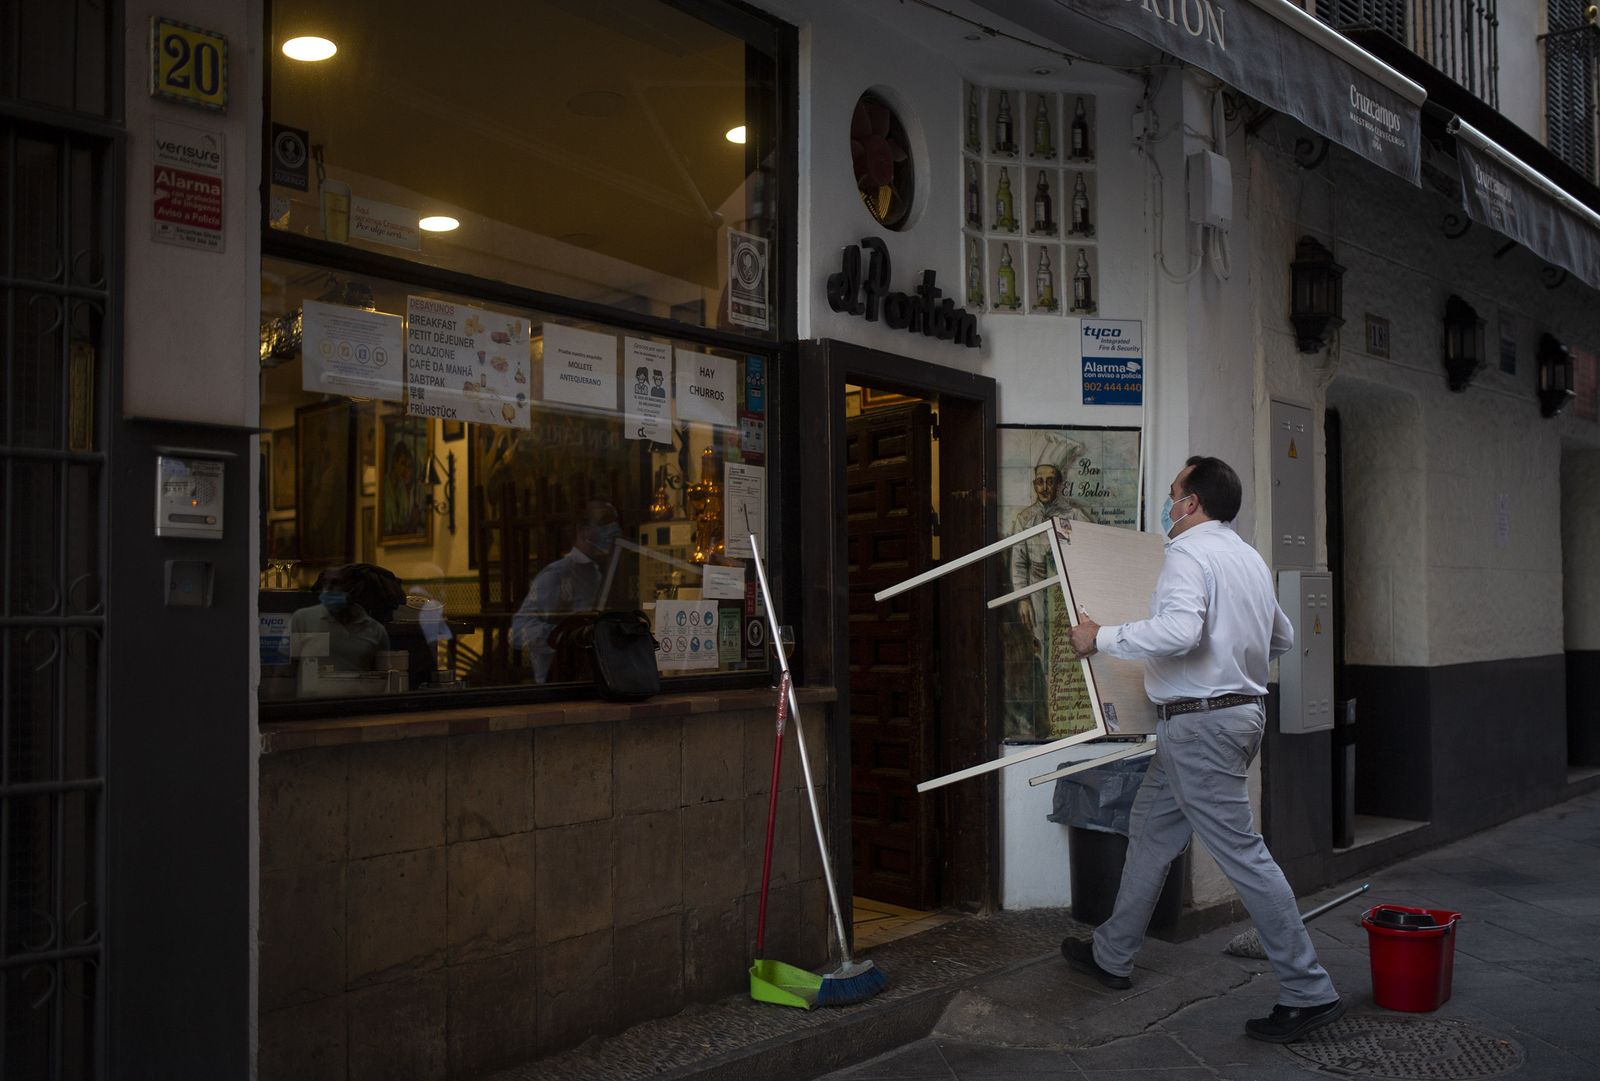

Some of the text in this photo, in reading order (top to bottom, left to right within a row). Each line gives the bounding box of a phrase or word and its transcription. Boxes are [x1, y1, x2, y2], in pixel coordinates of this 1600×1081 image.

[164, 34, 219, 95] 20
[1350, 84, 1400, 132] Cruzcampo
[156, 140, 220, 163] verisure
[156, 170, 220, 196] Alarma
[158, 207, 182, 218] Aviso
[185, 211, 190, 220] a
[410, 298, 455, 315] DESAYUNOS
[410, 314, 457, 331] BREAKFAST
[409, 329, 474, 349] PETIT DÉJEUNER
[1083, 326, 1122, 339] tyco
[409, 343, 455, 360] COLAZIONE
[1117, 345, 1140, 353] Security
[409, 357, 473, 377] CAFÉ DA MANHÃ
[567, 361, 593, 372] MOLLETE
[699, 367, 715, 379] HAY
[1084, 361, 1126, 373] Alarma
[560, 373, 602, 387] ANTEQUERANO
[1084, 382, 1142, 392] 902 444 440
[689, 385, 725, 401] CHURROS
[410, 403, 457, 418] FRÜHSTÜCK
[1078, 458, 1100, 476] Bar
[1061, 481, 1110, 497] El Portón
[260, 617, 284, 626] tyco
